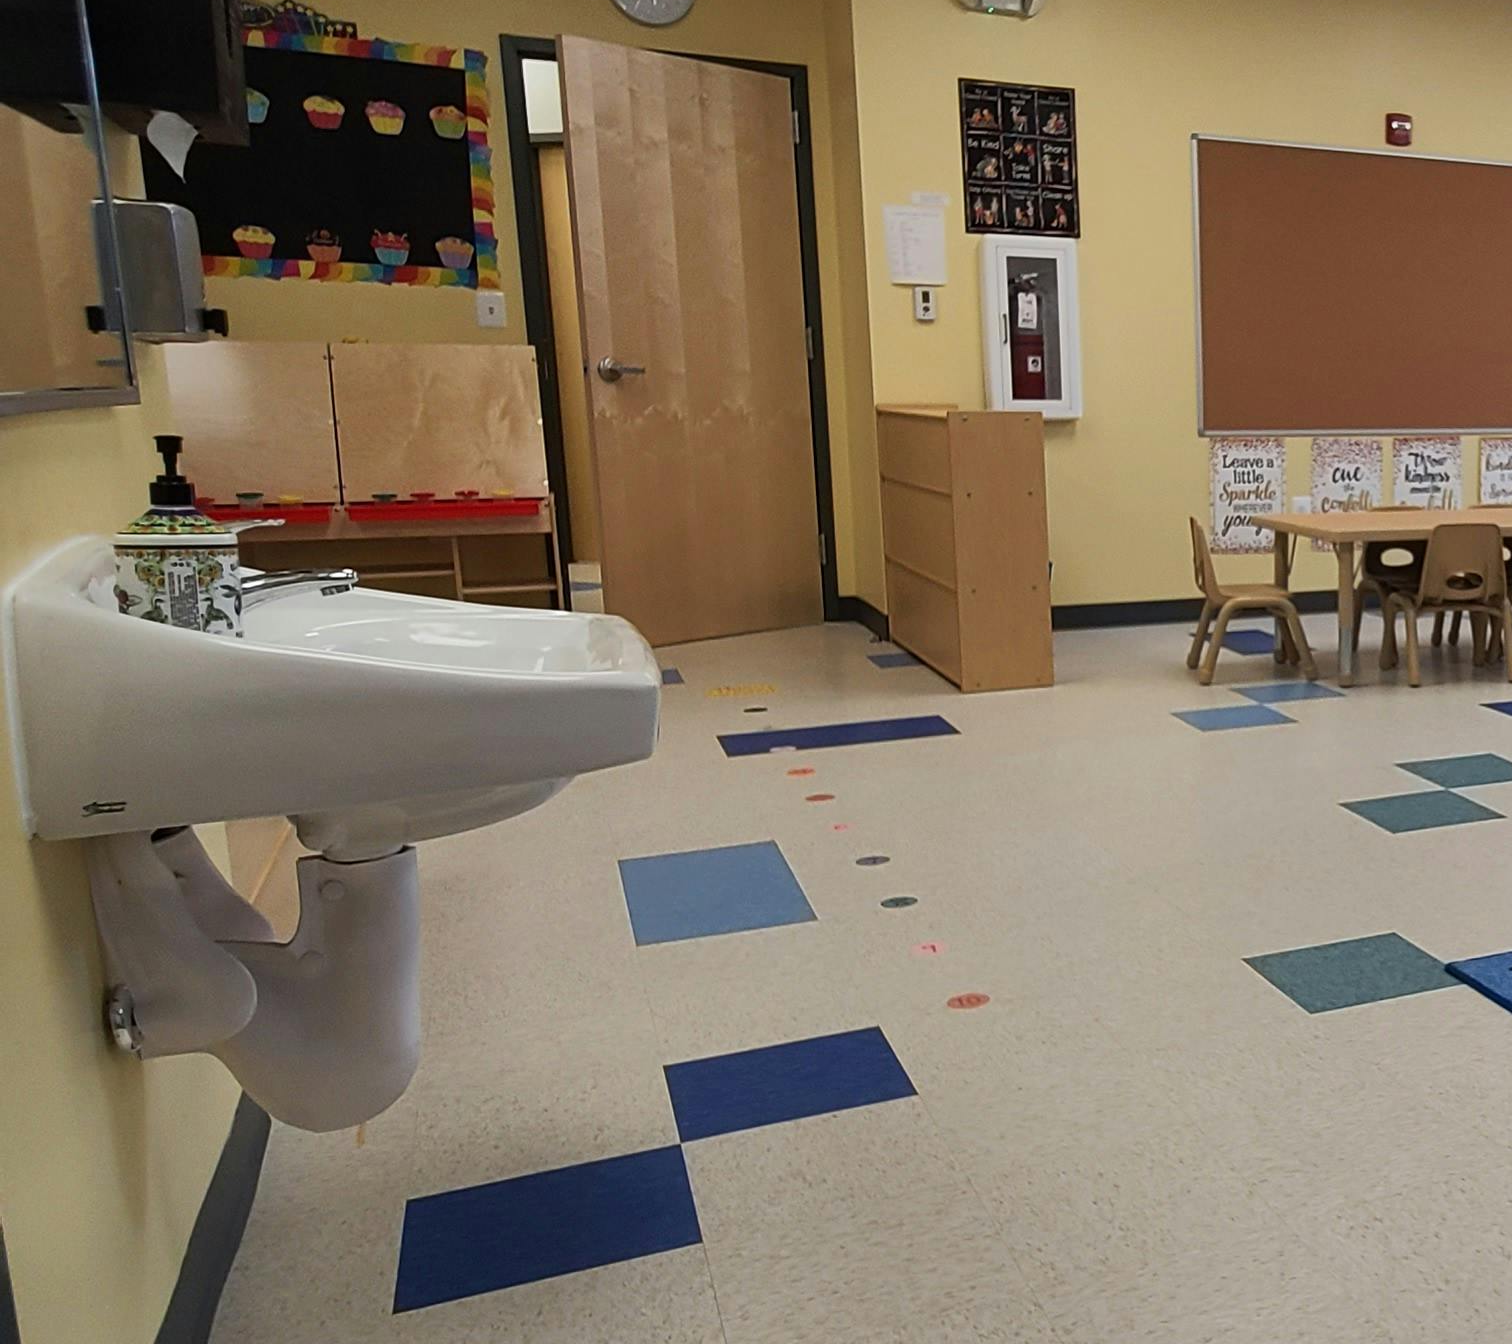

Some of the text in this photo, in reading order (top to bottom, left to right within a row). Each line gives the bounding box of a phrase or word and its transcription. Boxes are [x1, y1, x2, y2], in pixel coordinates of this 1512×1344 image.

[1222, 455, 1275, 469] Leave a
[1233, 469, 1265, 484] little
[1219, 480, 1277, 507] Sparkle
